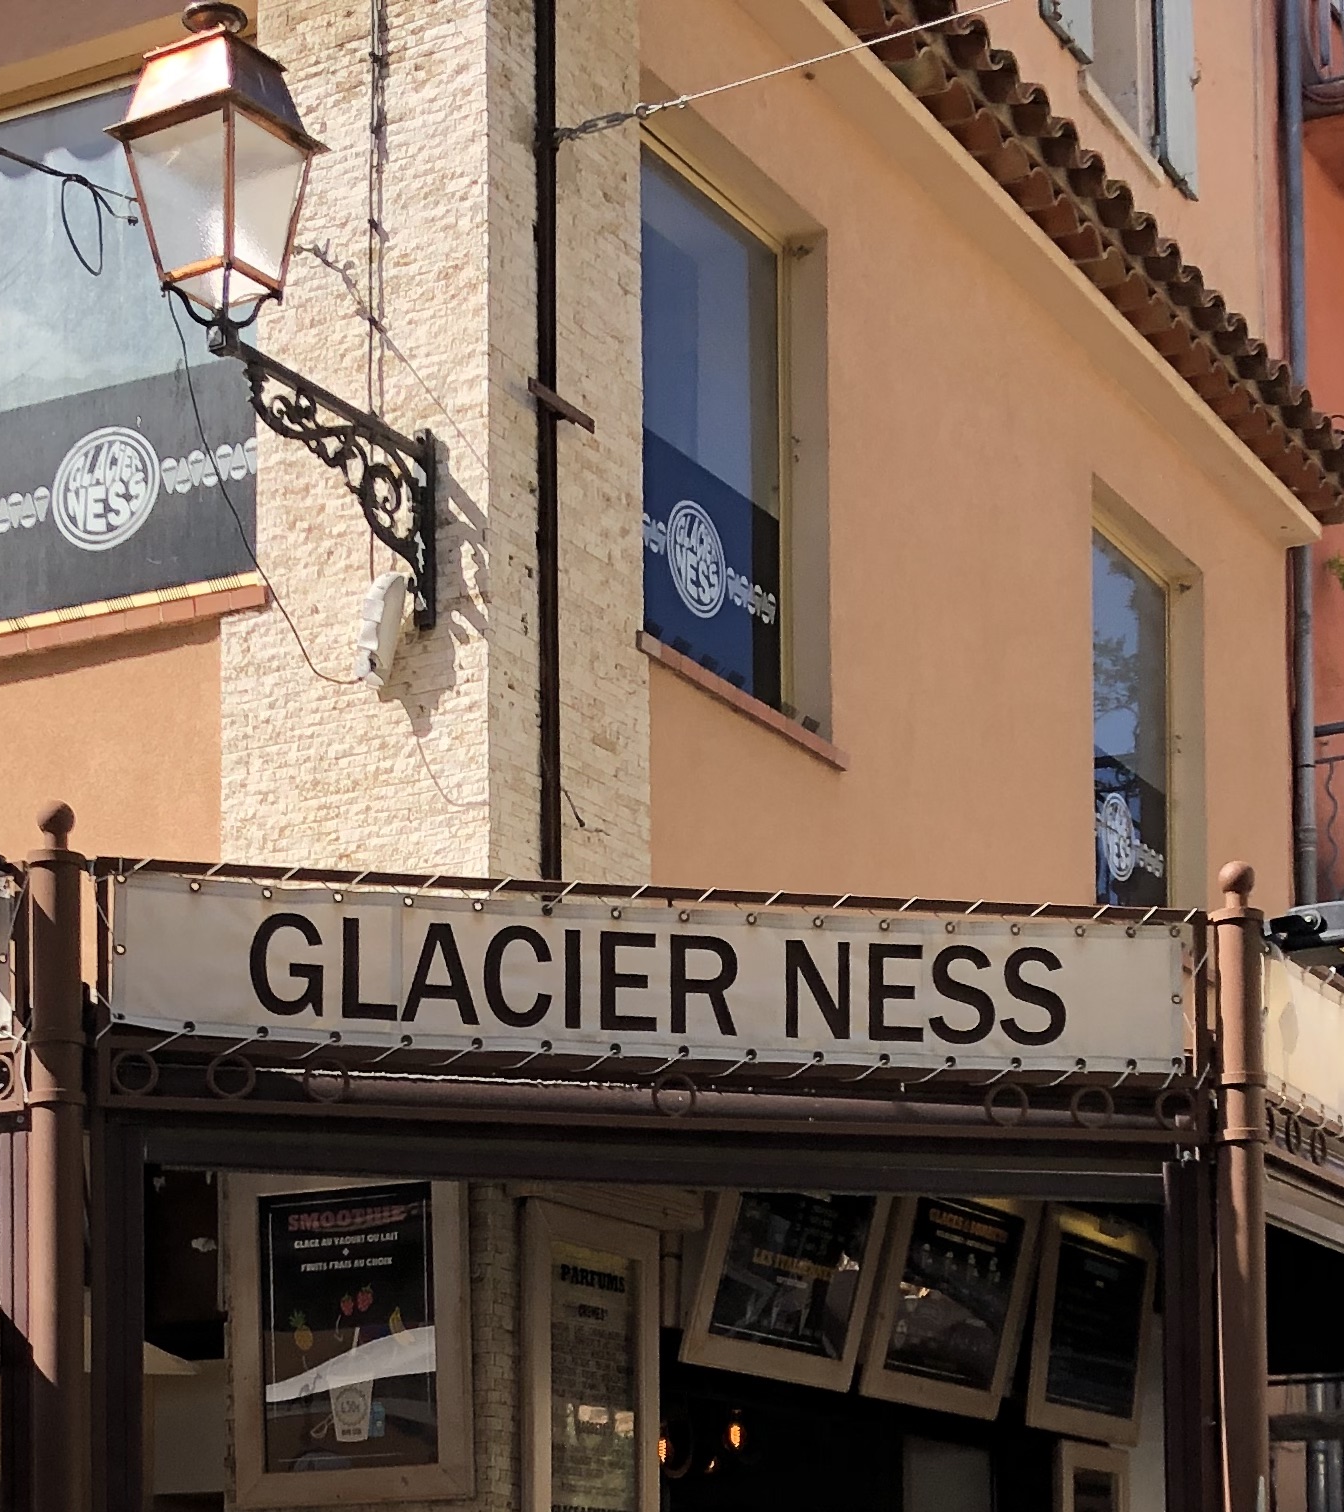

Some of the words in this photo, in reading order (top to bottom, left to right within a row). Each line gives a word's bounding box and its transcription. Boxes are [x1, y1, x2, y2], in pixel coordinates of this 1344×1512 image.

[67, 472, 146, 532] NESS
[676, 545, 719, 602] NESS
[249, 912, 739, 1036] GLACIER
[785, 940, 1067, 1046] NESS
[380, 1231, 398, 1242] LAIT
[300, 1262, 327, 1273] FRUITS
[329, 1260, 352, 1271] FRAIS
[561, 1263, 626, 1293] PARFUMS
